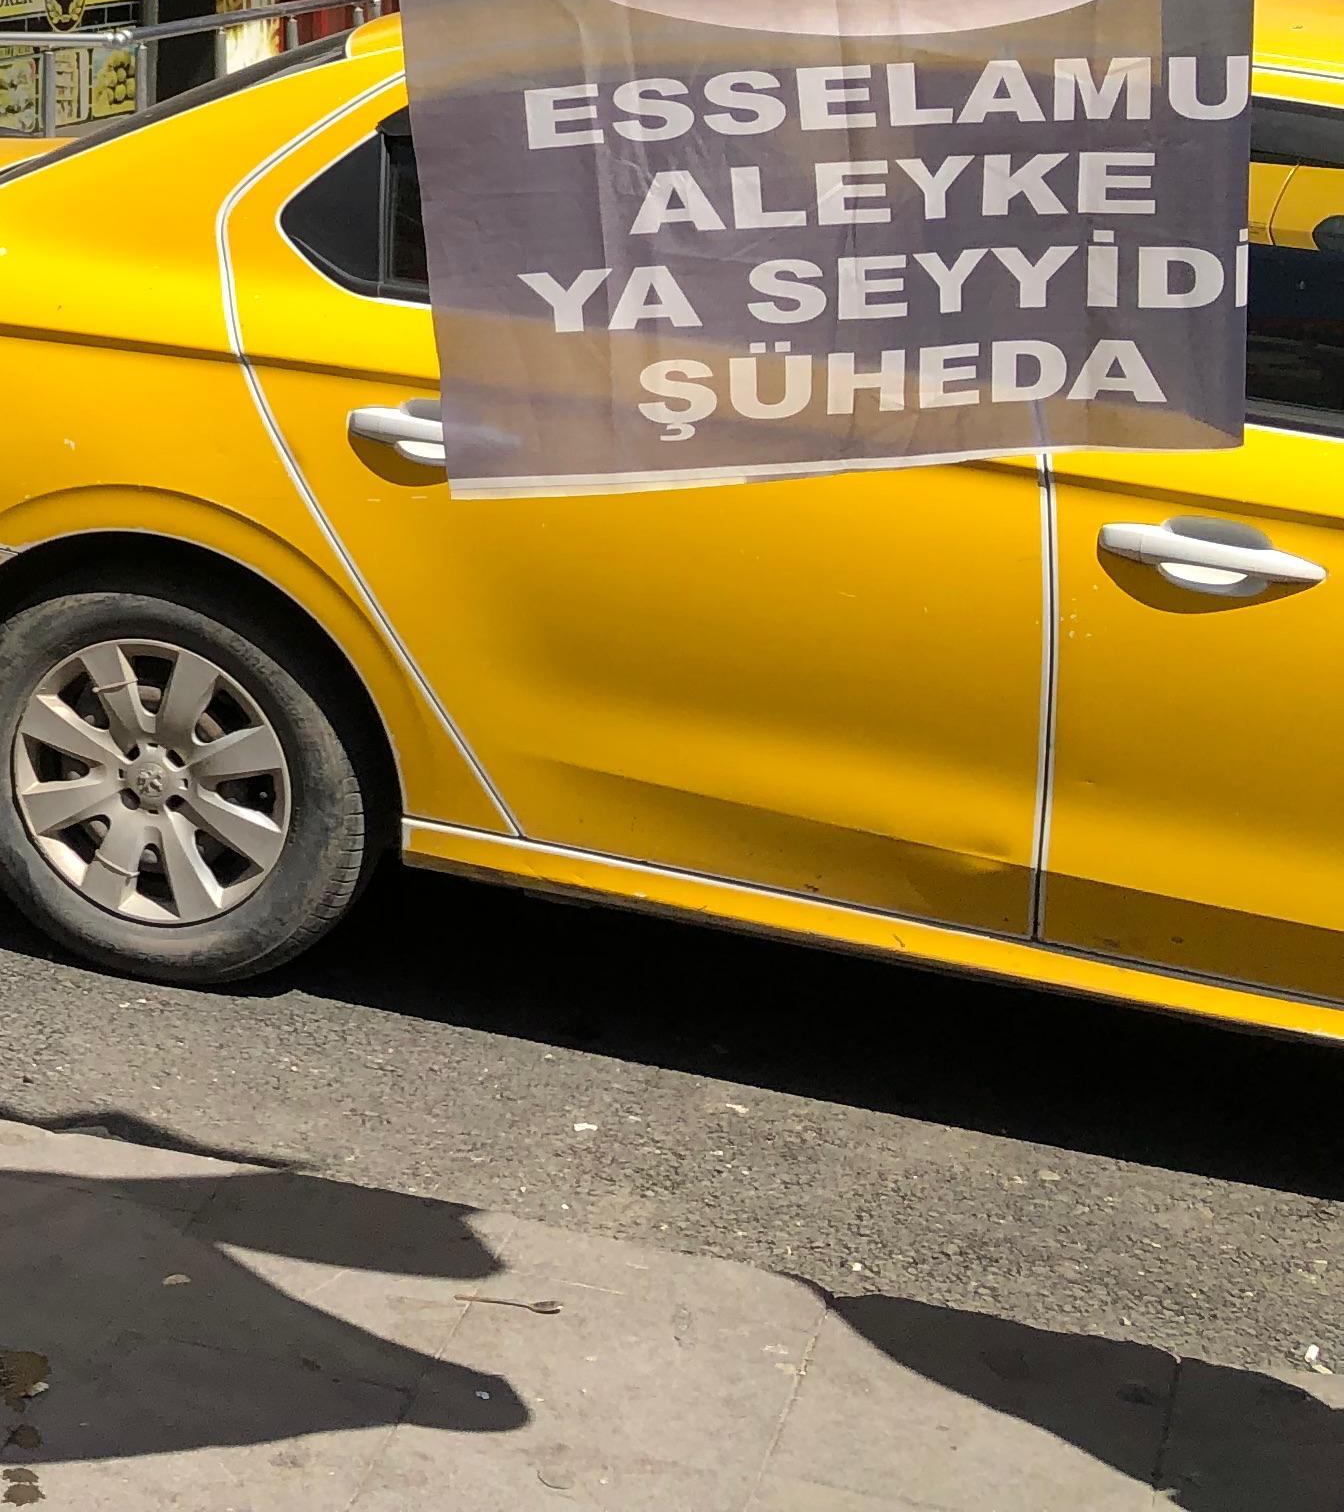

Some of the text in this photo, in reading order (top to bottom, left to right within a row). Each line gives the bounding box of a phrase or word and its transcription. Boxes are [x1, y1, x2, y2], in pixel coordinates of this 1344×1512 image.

[524, 55, 1249, 151] ESSELAMU
[630, 152, 1156, 235] ALEYKE
[518, 265, 703, 333] YA
[639, 339, 1167, 441] ŞÜHEDA
